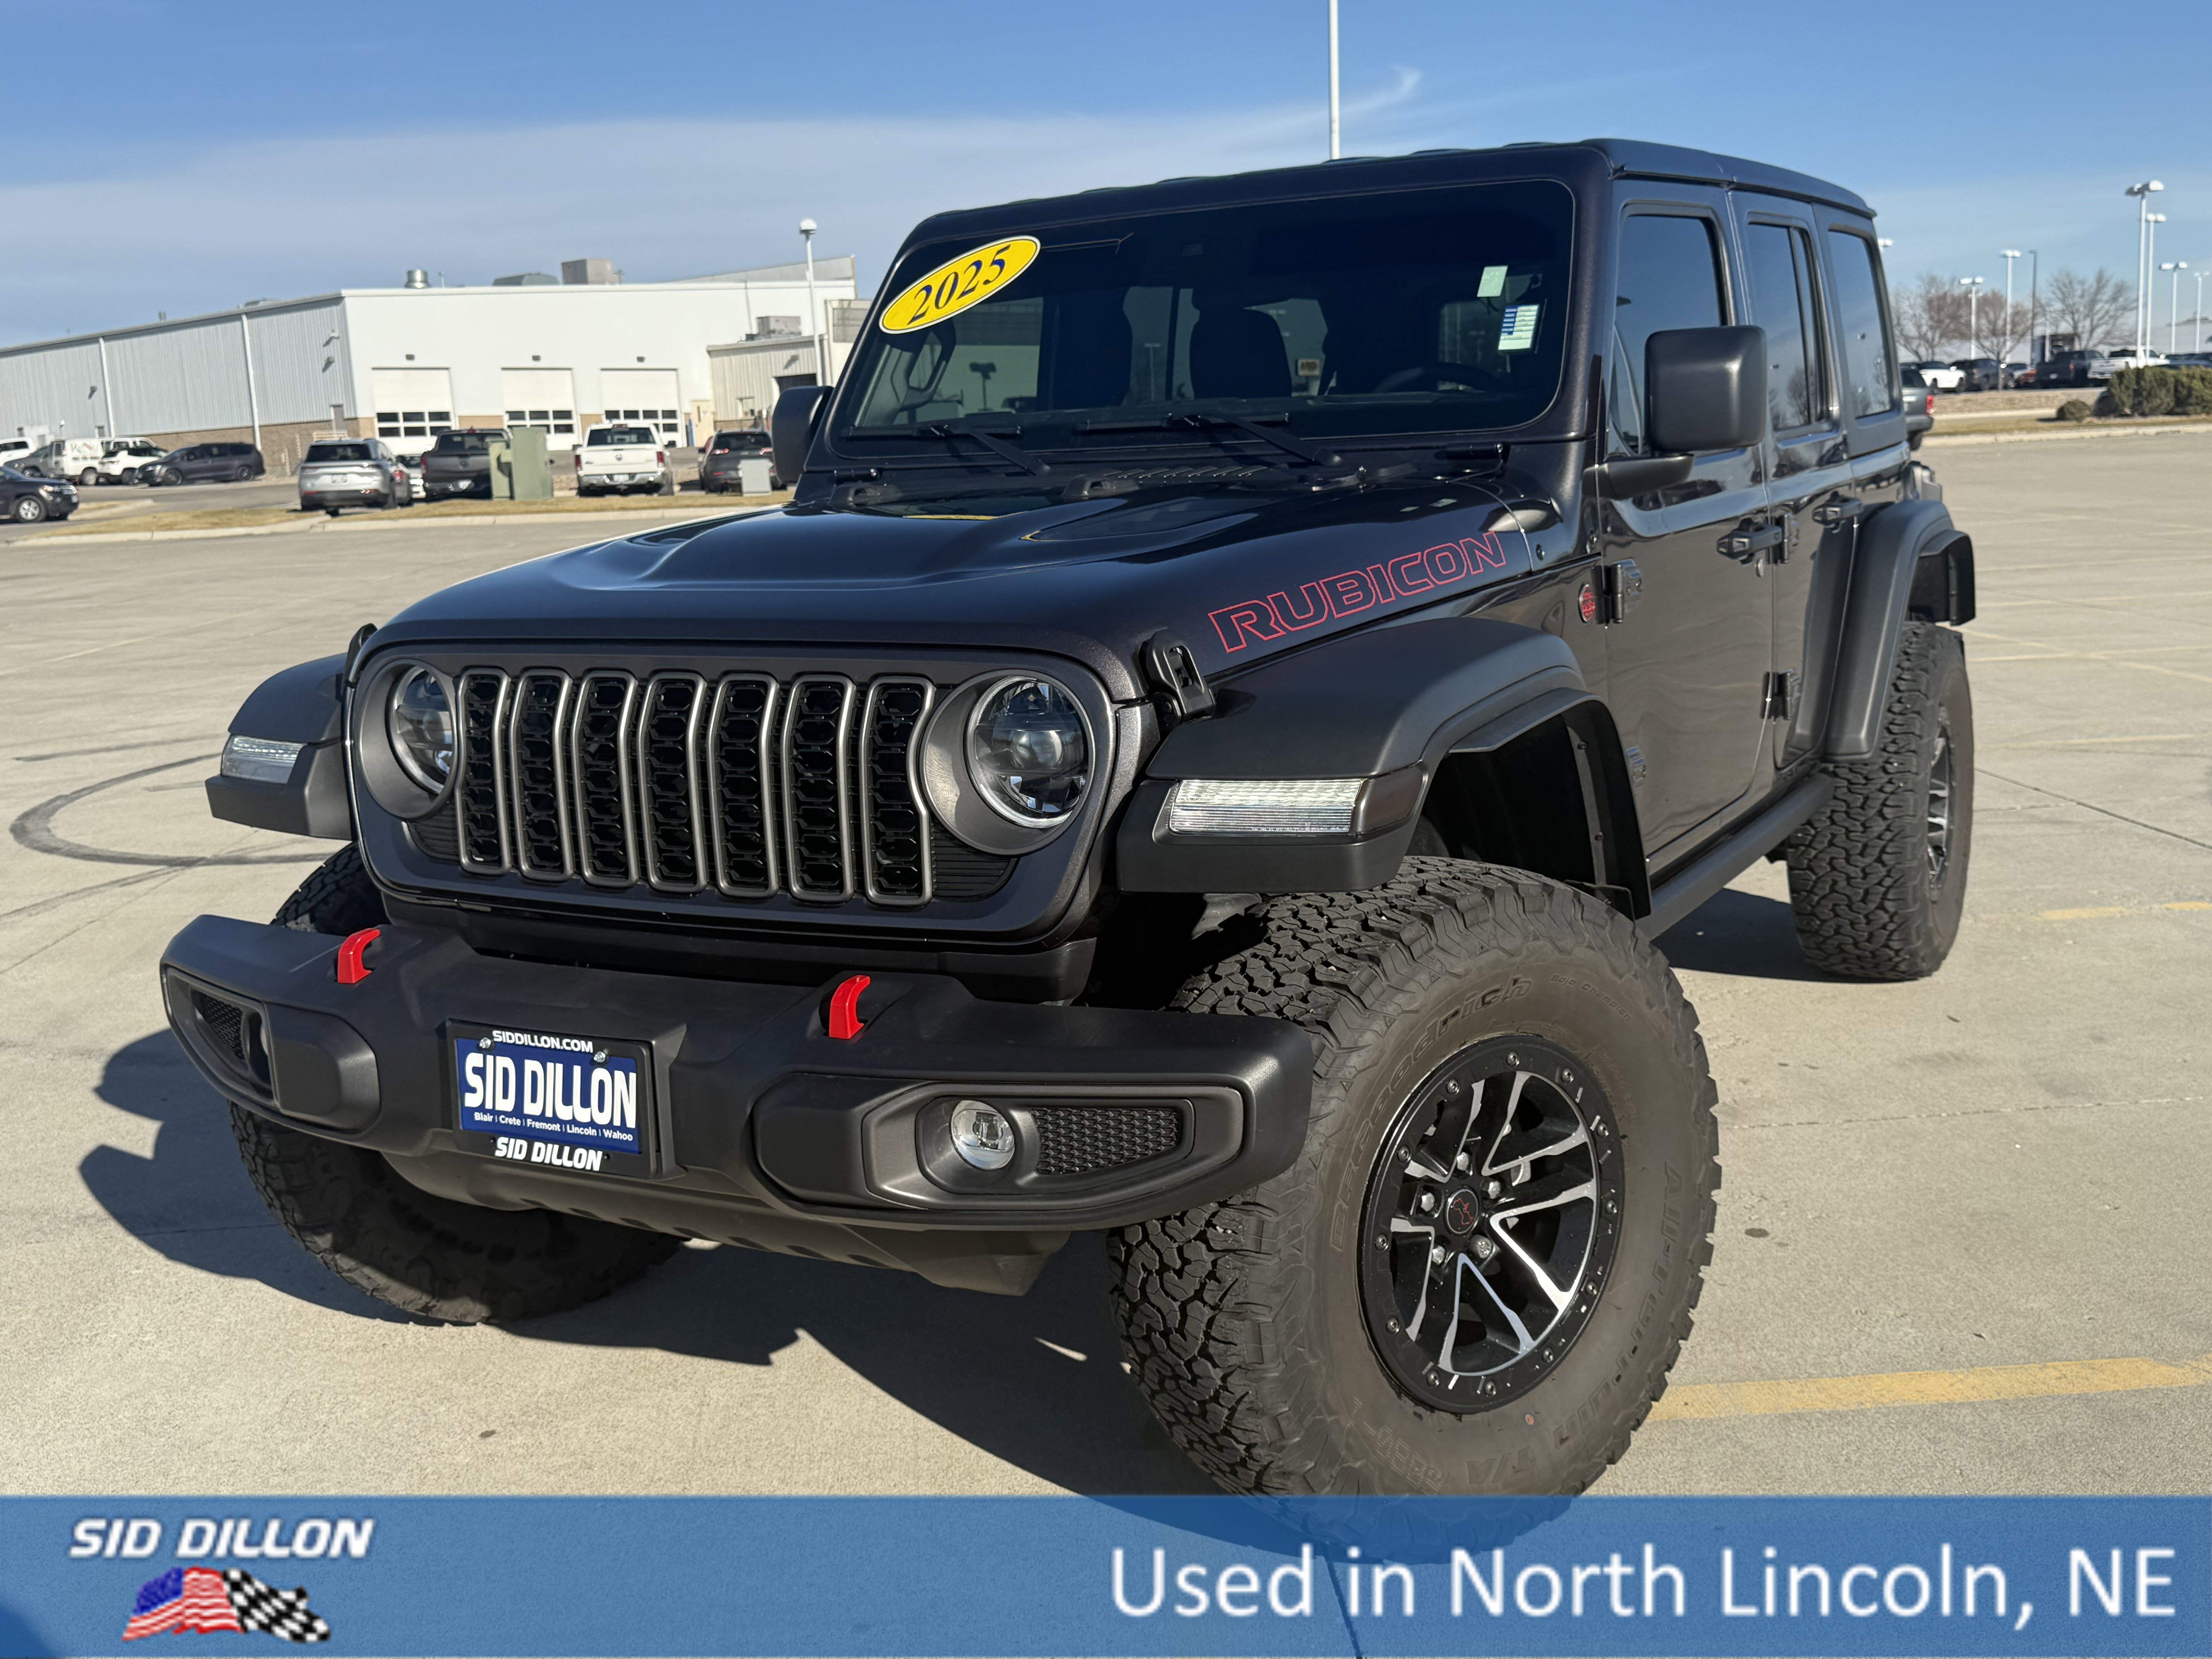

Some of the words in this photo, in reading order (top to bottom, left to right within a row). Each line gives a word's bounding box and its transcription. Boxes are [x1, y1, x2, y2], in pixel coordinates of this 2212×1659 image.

[907, 244, 1011, 325] 2025
[1207, 531, 1506, 653] RUBICON
[1550, 973, 1577, 987] Baja
[1581, 982, 1632, 1022] Champion
[492, 1030, 593, 1053] SIDDILLON.COM
[464, 1052, 516, 1112] SID
[524, 1059, 637, 1129] DILLON
[1330, 977, 1534, 1252] BFGoodrich
[474, 1112, 493, 1122] Blair
[500, 1115, 521, 1126] Crete
[527, 1118, 560, 1132] Fremont
[567, 1124, 597, 1137] Lincoln
[603, 1129, 633, 1141] Wahoo
[495, 1137, 527, 1161] SID
[531, 1142, 604, 1171] DILLON
